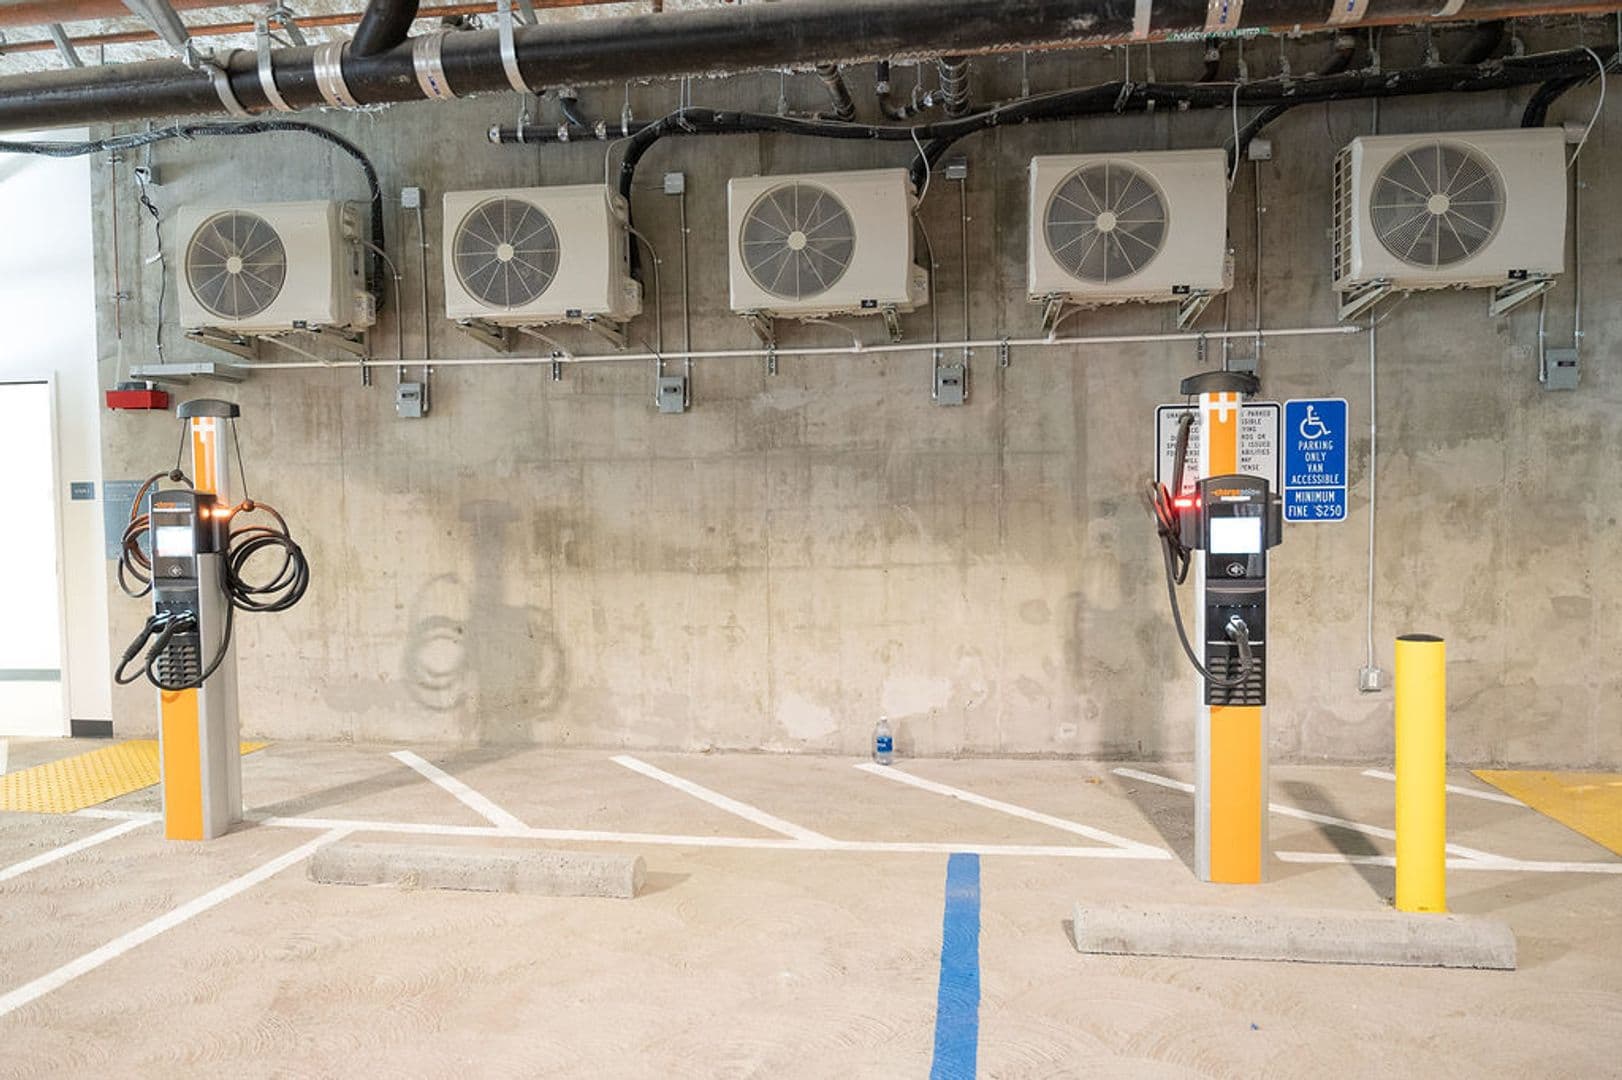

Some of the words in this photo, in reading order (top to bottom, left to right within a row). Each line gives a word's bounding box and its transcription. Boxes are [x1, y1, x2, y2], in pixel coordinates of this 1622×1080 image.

[1298, 440, 1334, 451] PARKING
[1304, 451, 1327, 462] ONLY
[1307, 462, 1324, 473] VAN
[1290, 473, 1341, 485] ACCESSIBLE
[1295, 490, 1335, 503] MINIMUM
[1288, 504, 1309, 517] FINE
[1314, 504, 1343, 517] $250
